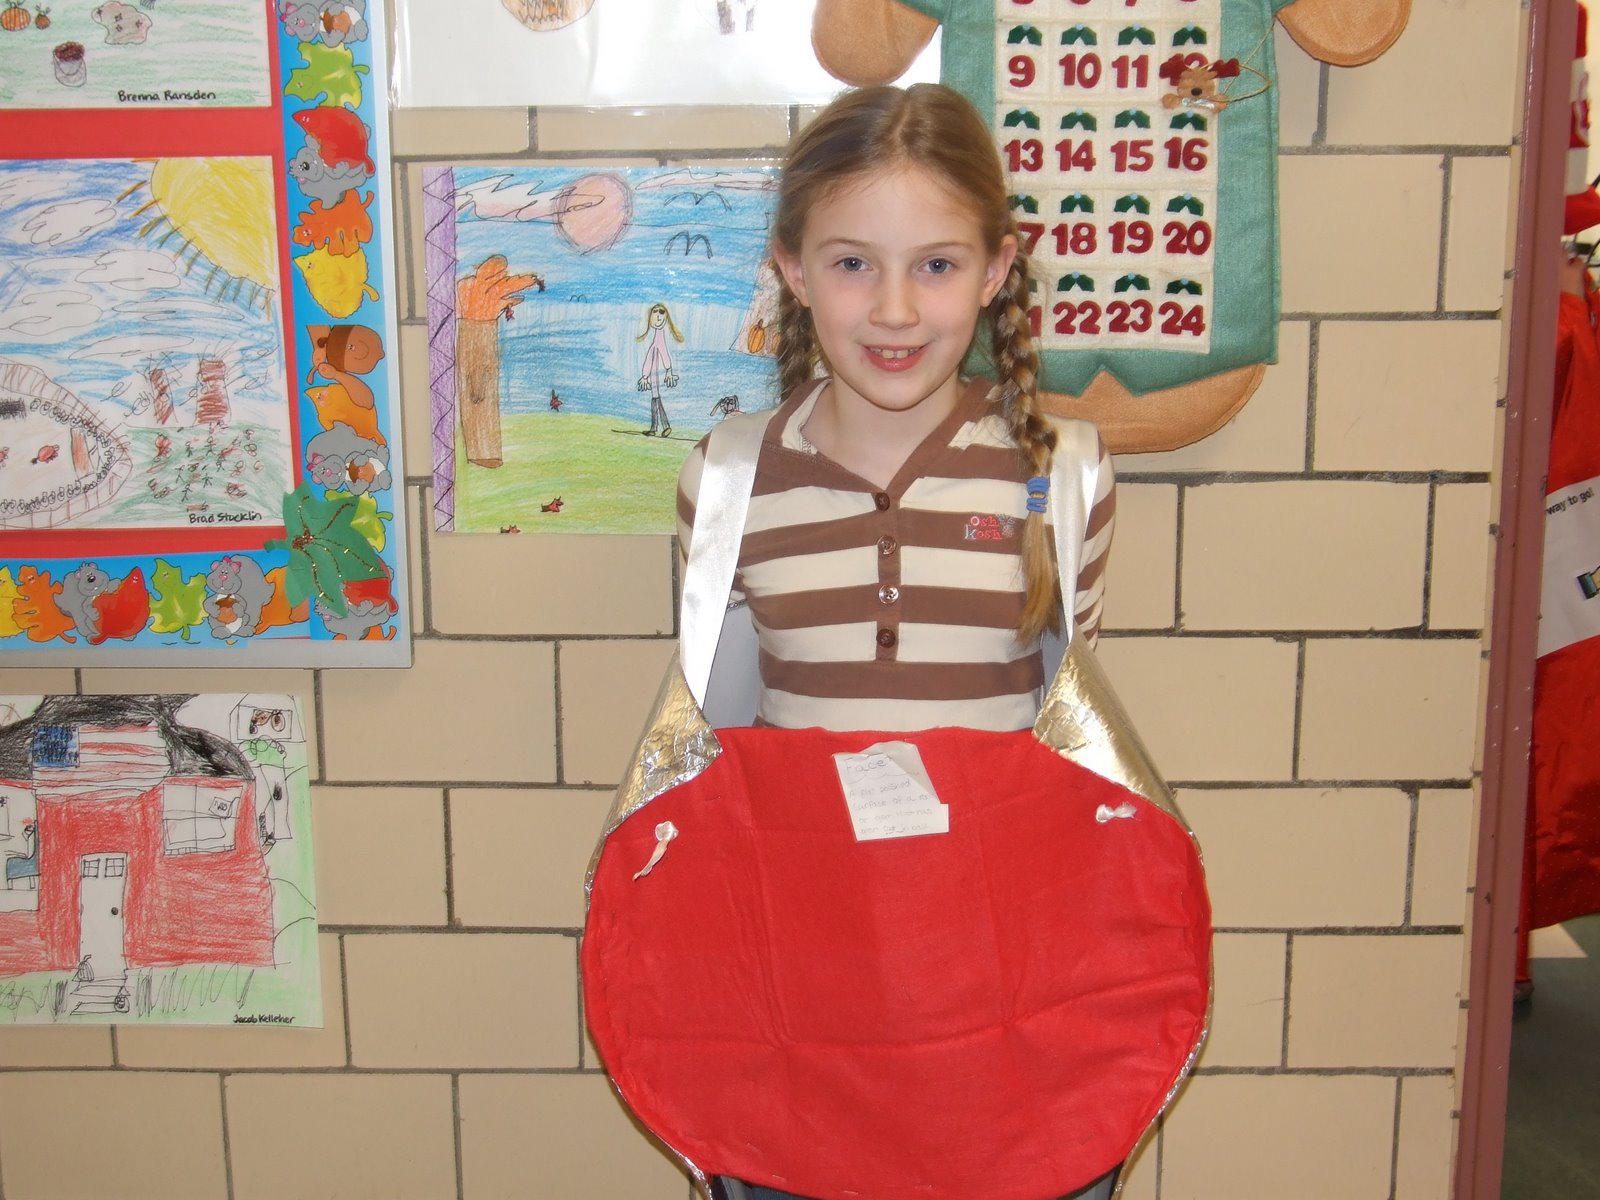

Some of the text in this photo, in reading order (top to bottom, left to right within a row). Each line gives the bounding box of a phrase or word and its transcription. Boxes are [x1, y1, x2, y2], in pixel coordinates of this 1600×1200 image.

[1008, 55, 1035, 88] 9
[1060, 53, 1101, 89] 10
[1112, 55, 1148, 88] 11
[118, 90, 160, 102] Brenna
[1006, 137, 1207, 173] 13 14 15 16
[1016, 221, 1212, 256] 7 18 19 20
[1053, 300, 1102, 335] 22
[1106, 299, 1153, 333] 23
[1159, 301, 1205, 337] 24
[189, 513, 215, 524] Brad
[1545, 487, 1595, 515] way to go!
